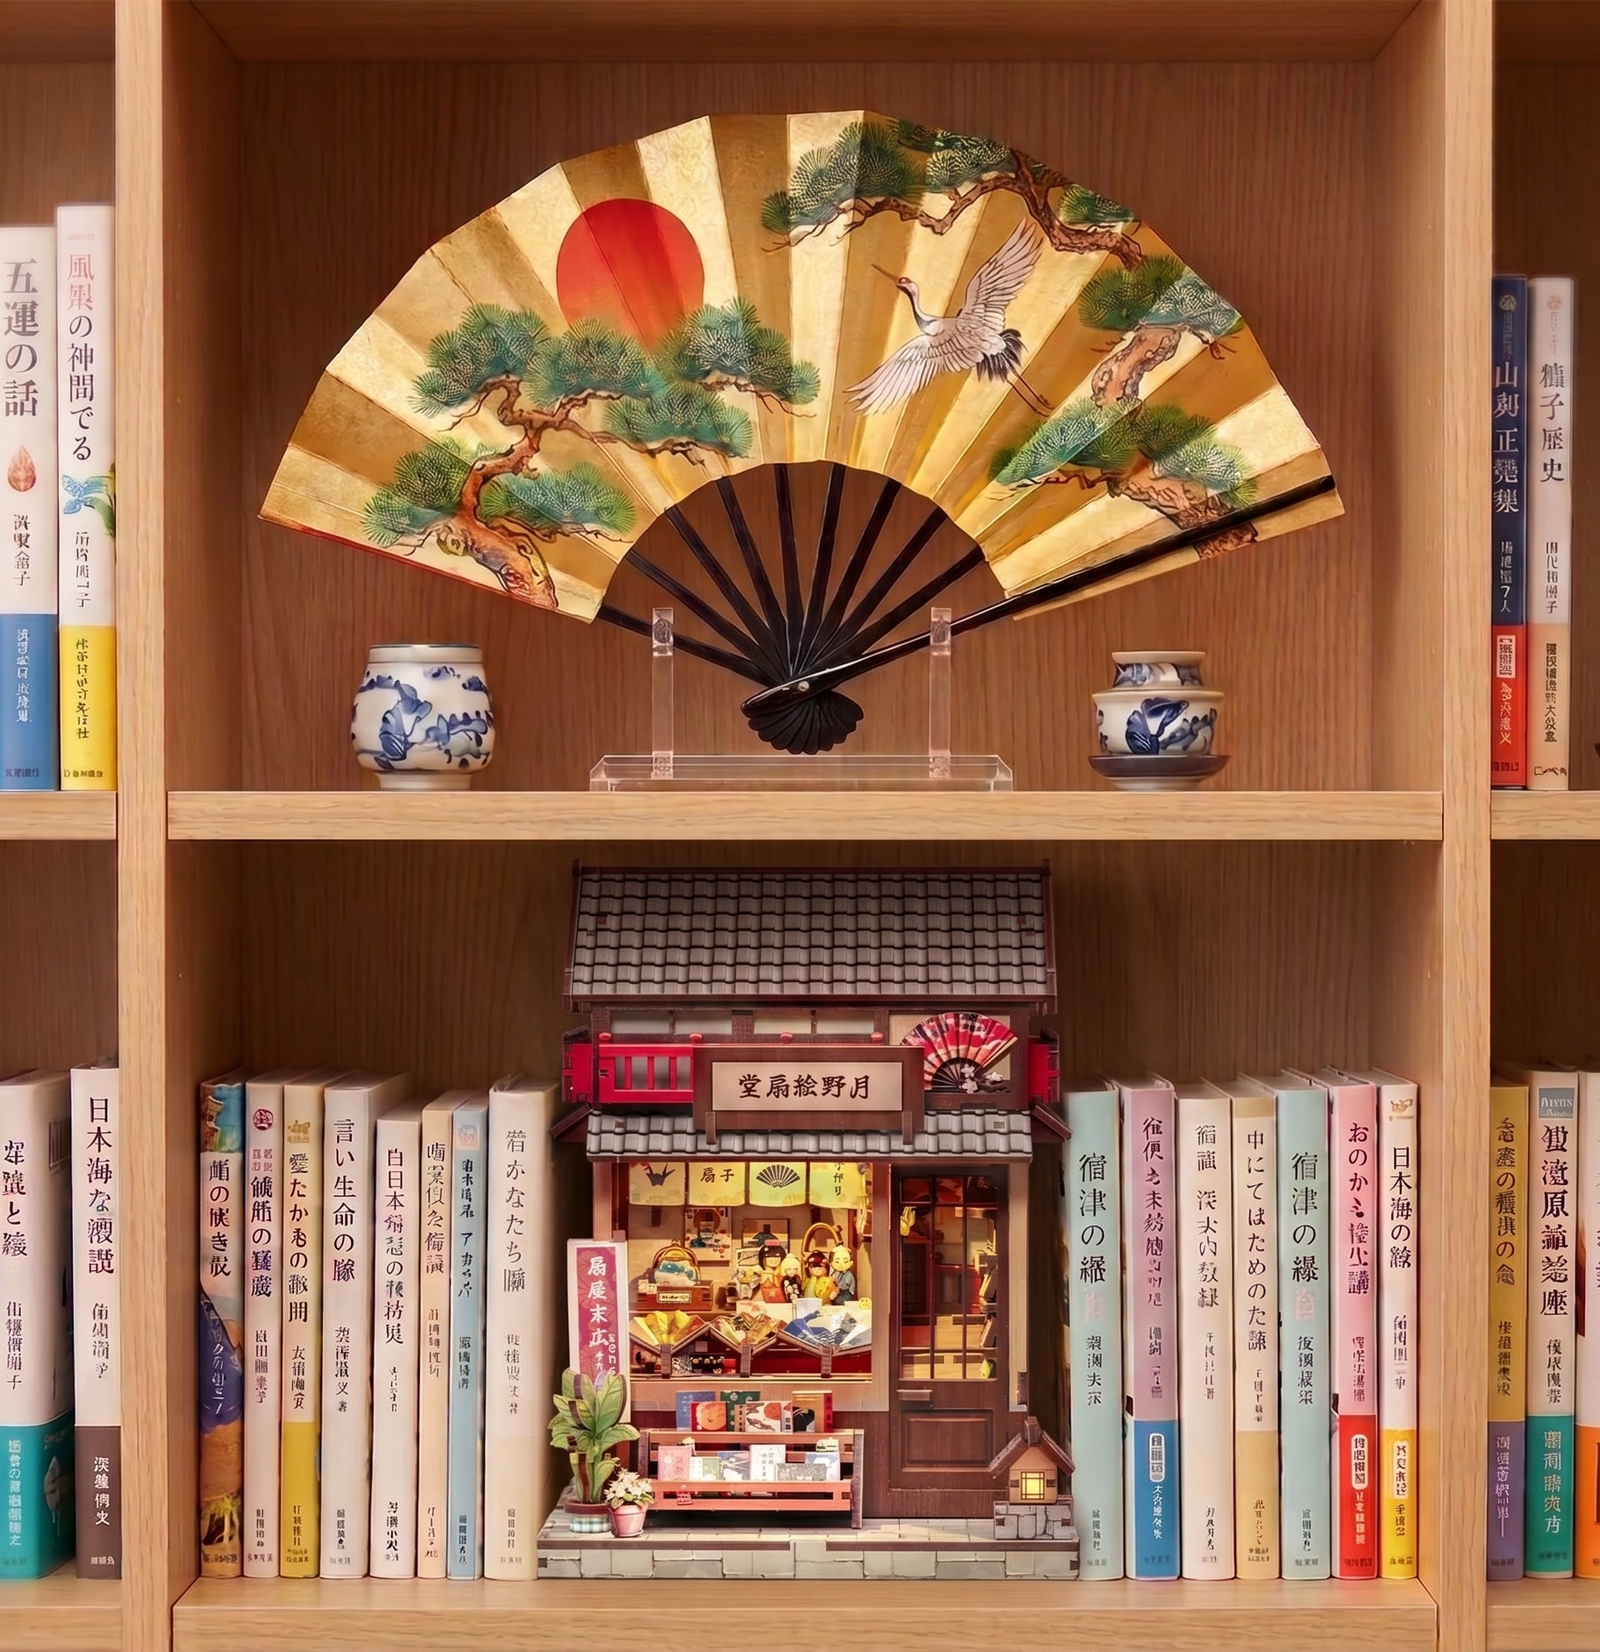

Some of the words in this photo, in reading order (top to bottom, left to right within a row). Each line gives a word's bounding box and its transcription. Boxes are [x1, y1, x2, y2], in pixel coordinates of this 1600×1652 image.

[3, 257, 40, 417] 五運の話
[700, 1167, 735, 1183] 扇子
